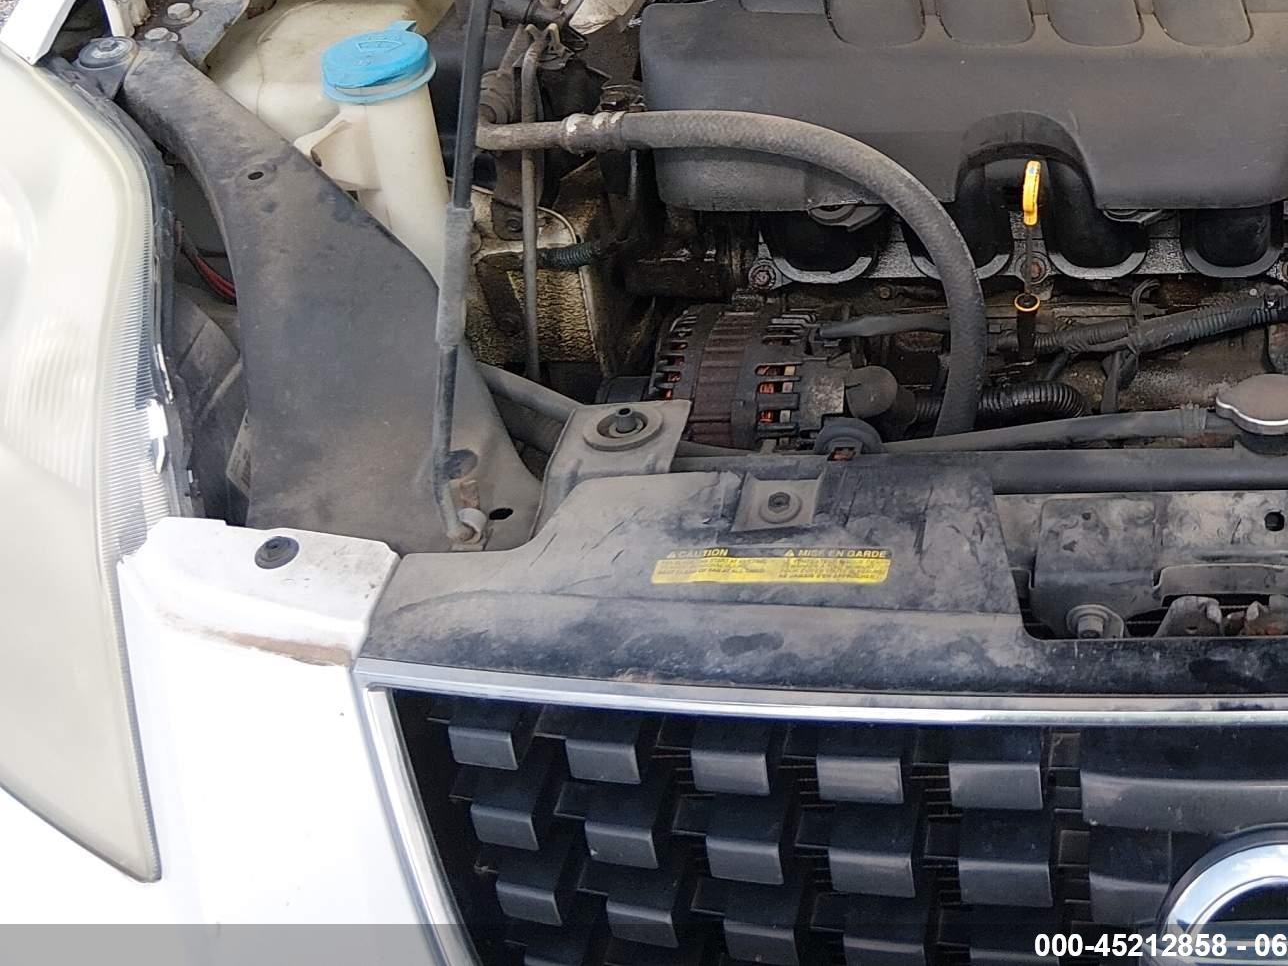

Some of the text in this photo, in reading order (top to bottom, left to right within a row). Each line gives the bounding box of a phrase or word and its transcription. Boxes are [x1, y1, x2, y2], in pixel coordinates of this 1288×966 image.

[677, 548, 729, 559] CAUTION
[798, 549, 889, 558] MISE EN GARDE
